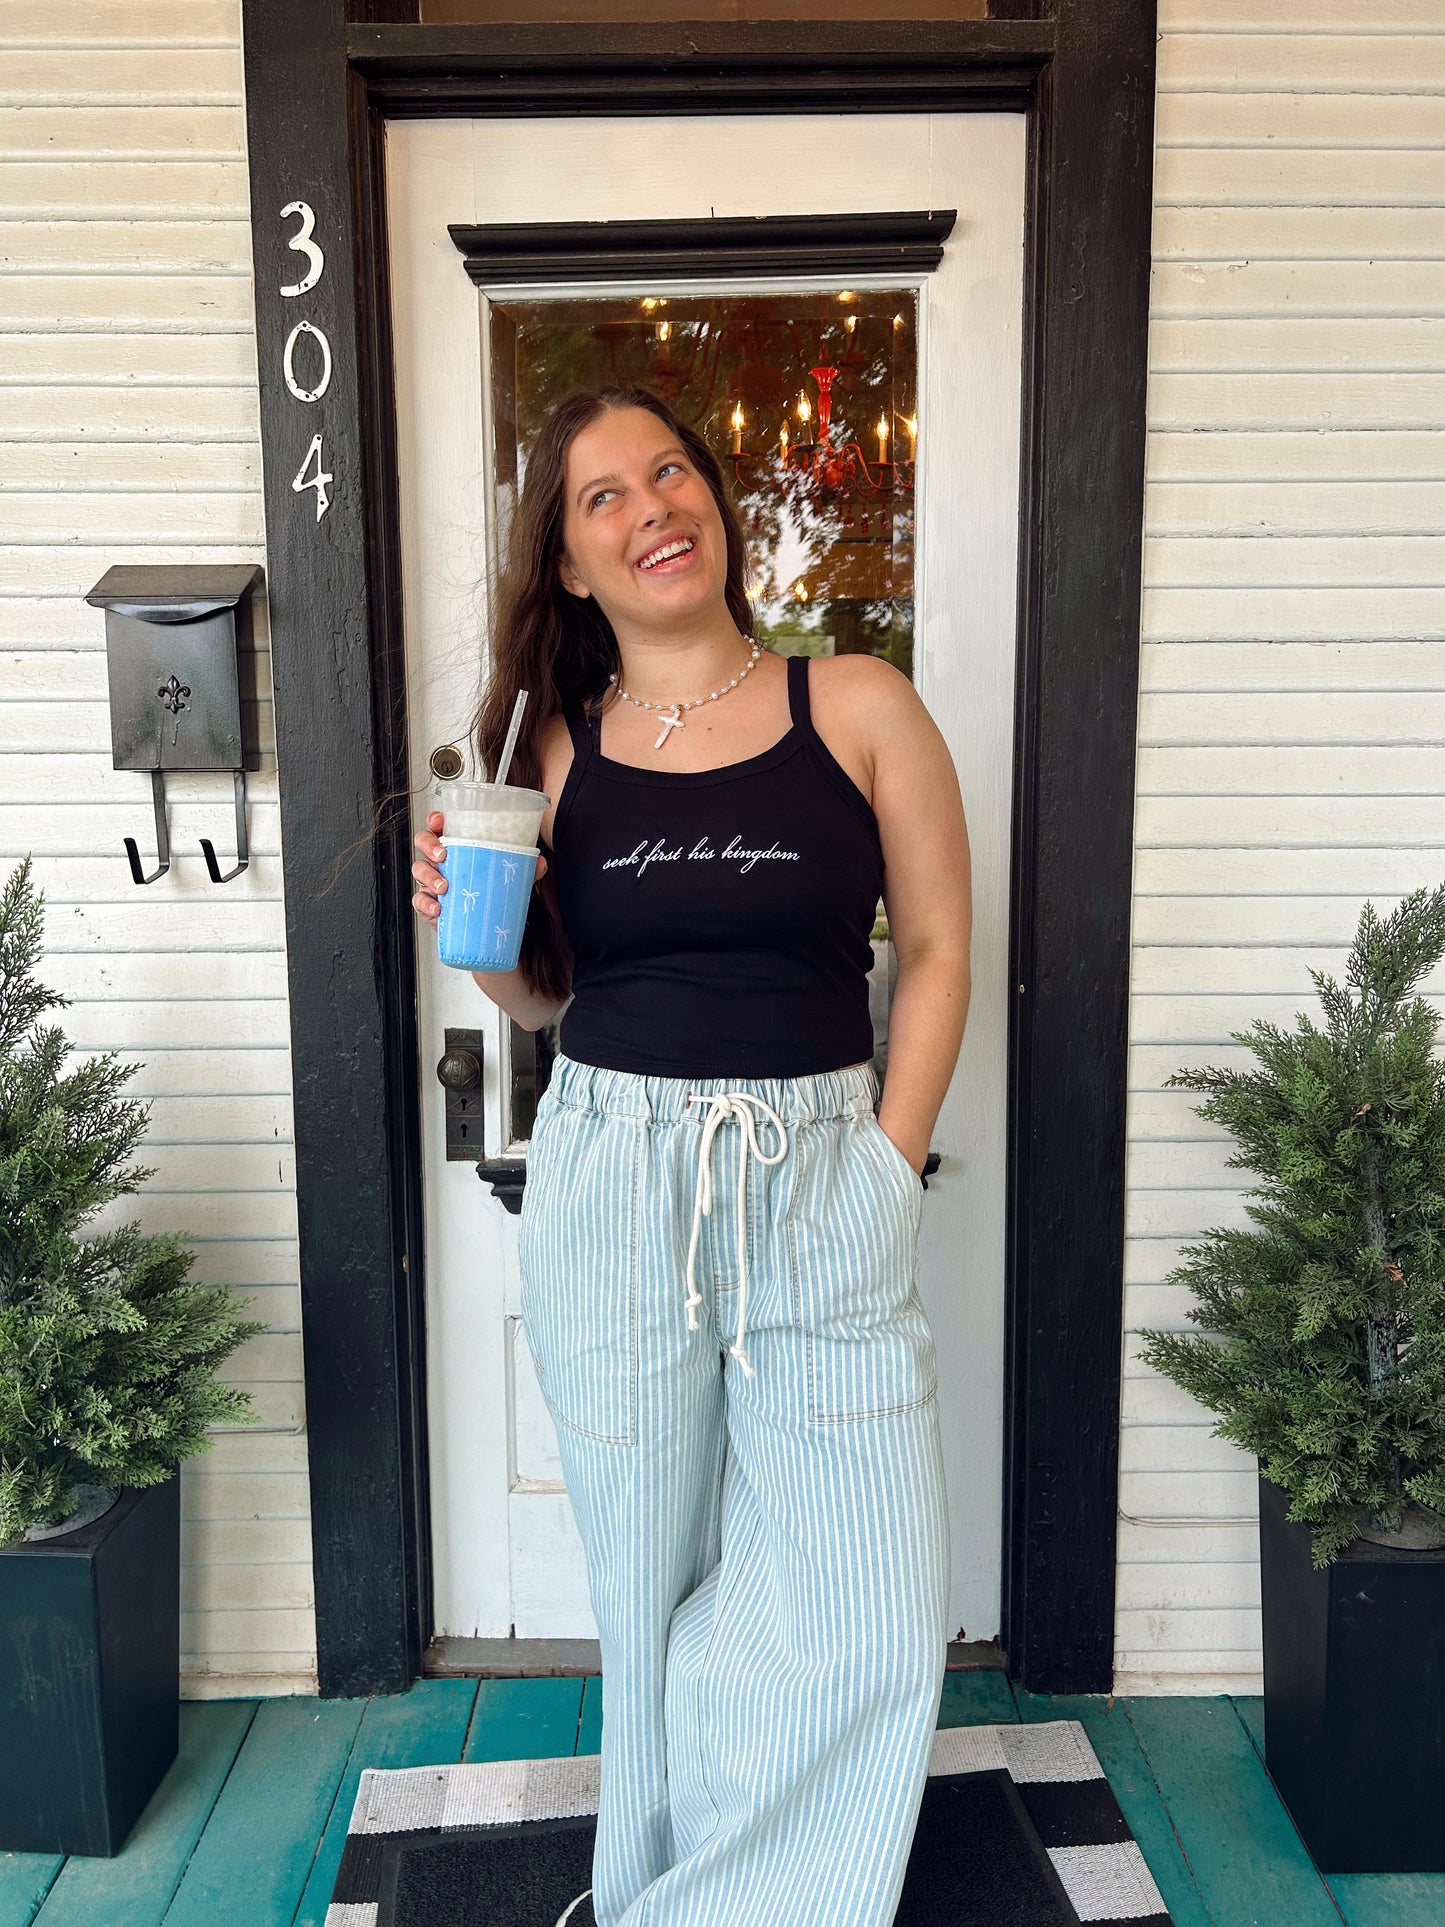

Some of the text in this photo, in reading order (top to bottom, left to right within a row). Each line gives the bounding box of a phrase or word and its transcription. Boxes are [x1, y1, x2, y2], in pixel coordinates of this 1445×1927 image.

[279, 200, 333, 523] 304
[602, 834, 801, 878] seek first his kingdom
